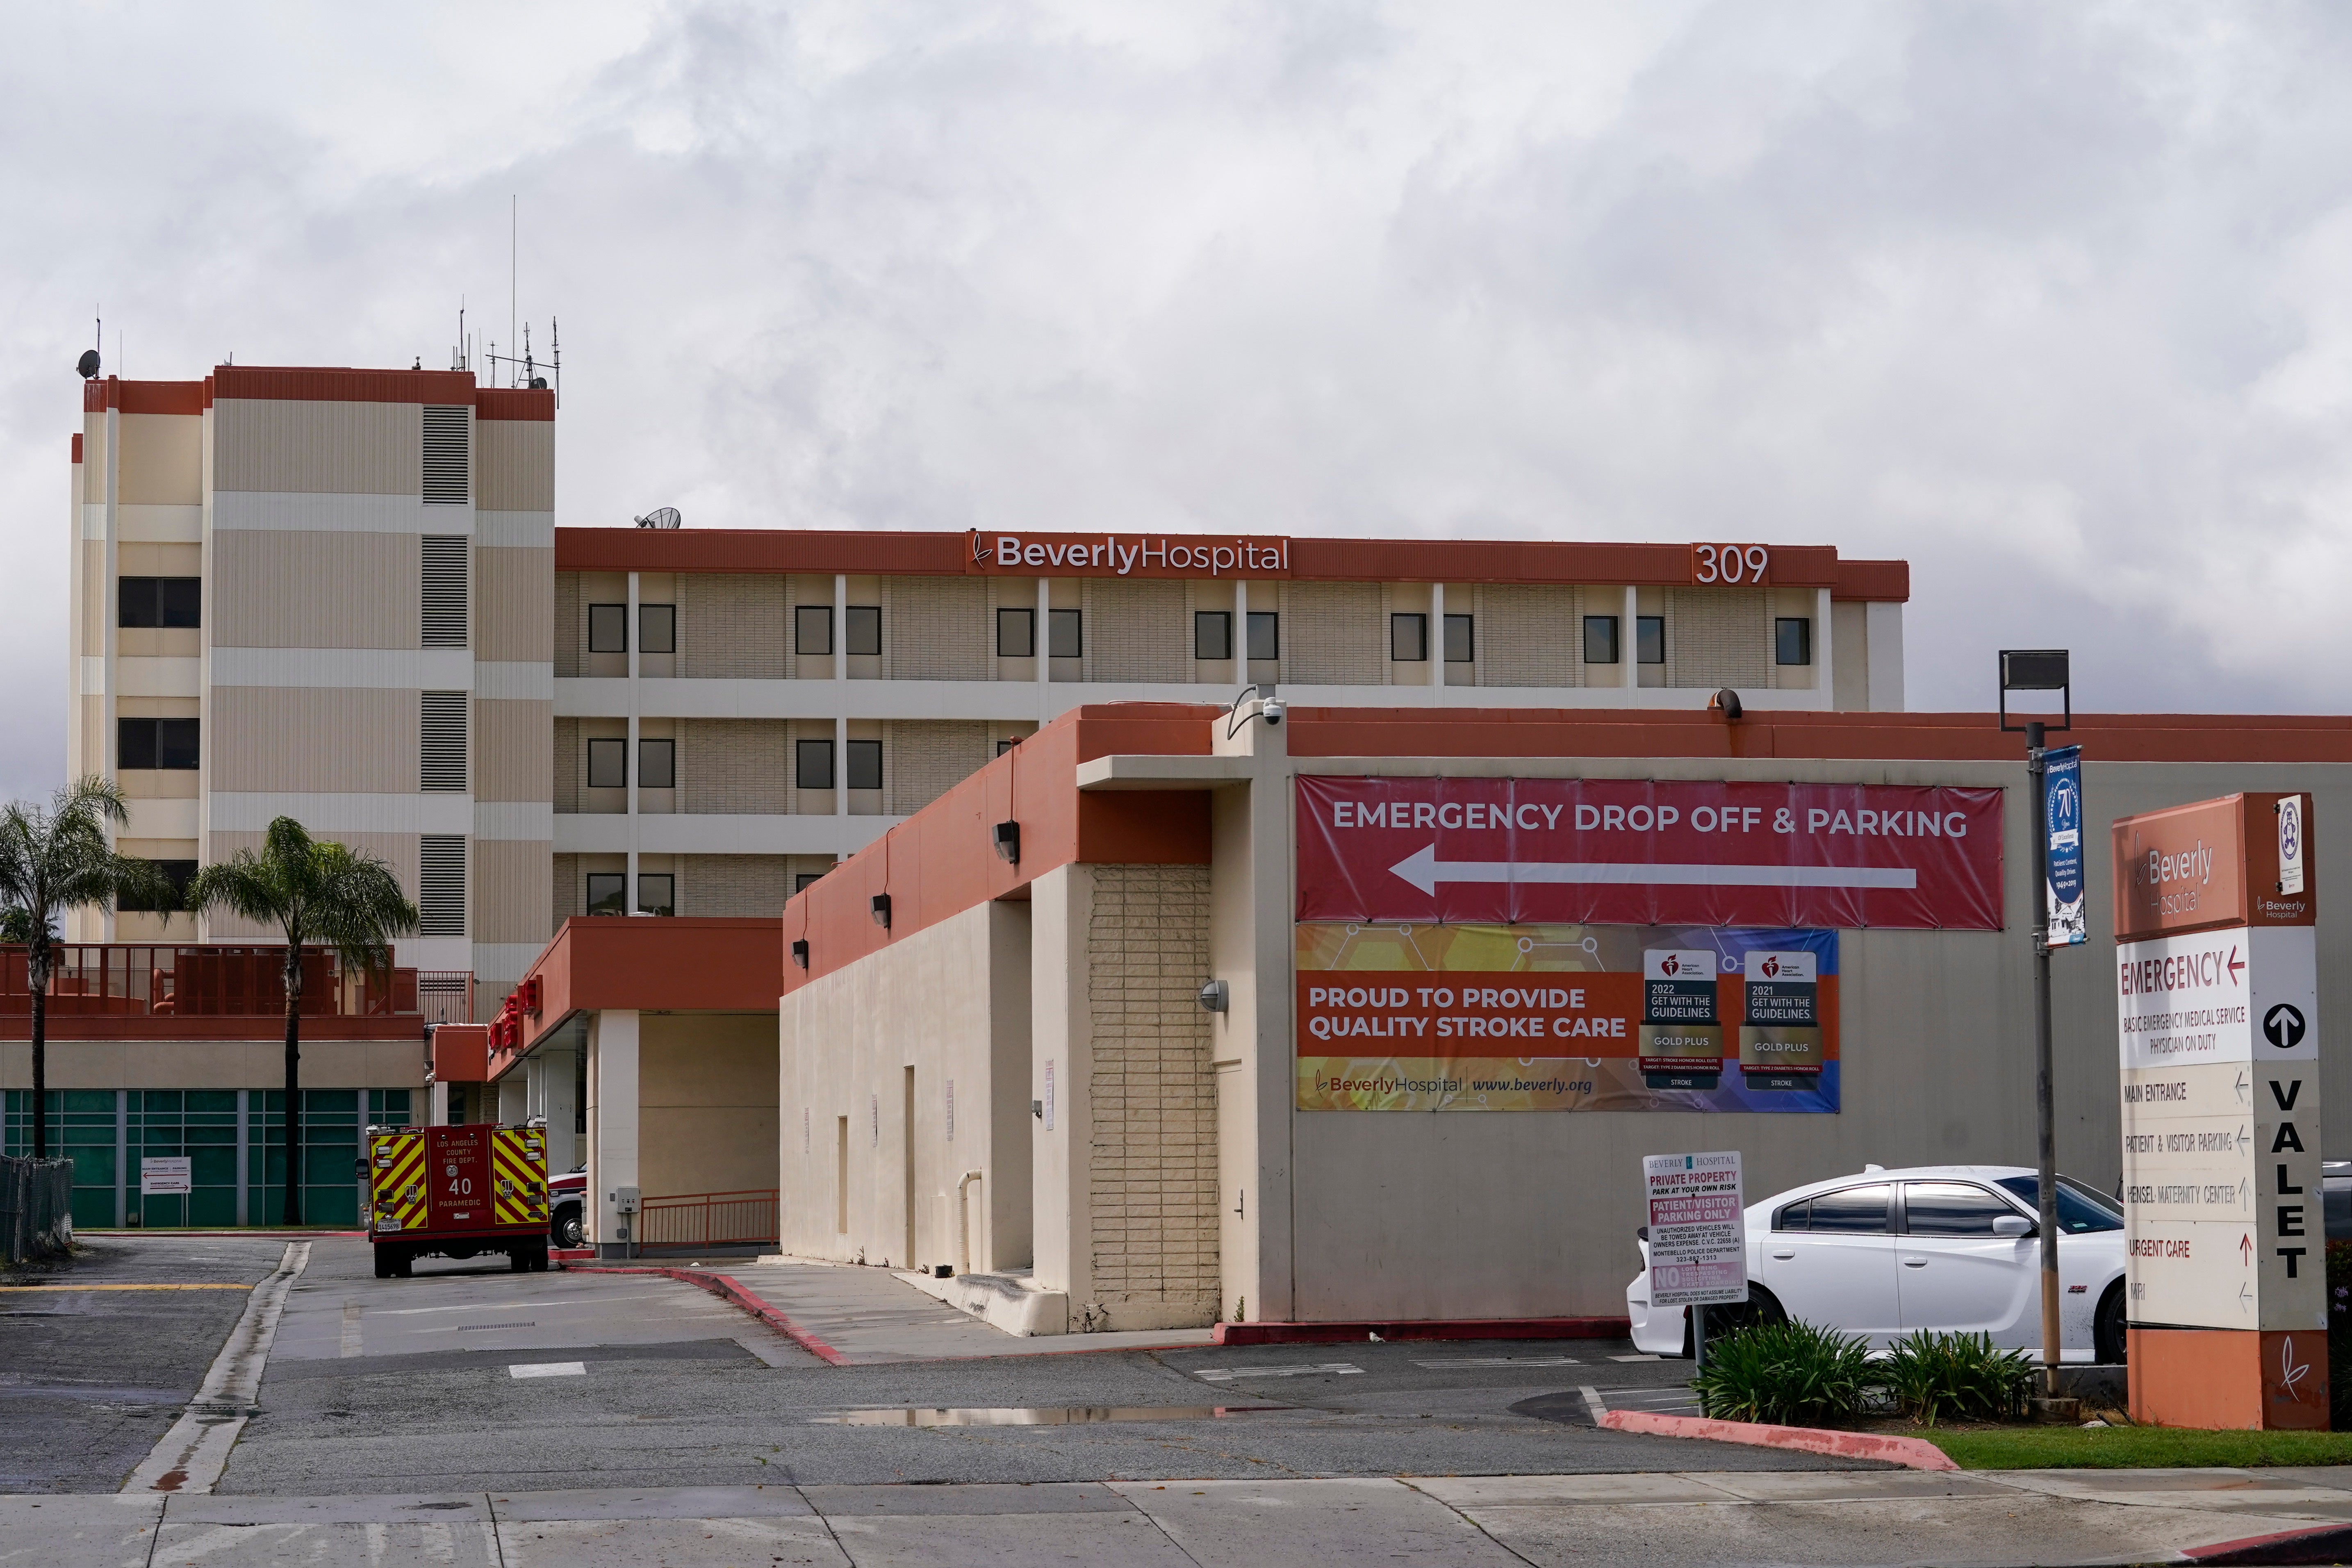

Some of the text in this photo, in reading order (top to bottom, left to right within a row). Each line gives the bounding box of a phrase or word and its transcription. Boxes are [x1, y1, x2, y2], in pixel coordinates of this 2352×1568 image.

[1696, 545, 1768, 583] 309
[2058, 788, 2070, 818] 70
[1334, 801, 1967, 838] EMERGENCY DROP OFF & PARKING
[2149, 839, 2212, 885] Beverly
[2150, 882, 2200, 919] Hospital
[2266, 901, 2305, 912] Beverly
[2266, 911, 2297, 919] Hospital
[2122, 951, 2223, 995] EMERGENCY
[1652, 984, 1674, 994] 2022
[1752, 986, 1773, 995] 2021
[1309, 988, 1585, 1008] PROUD TO PROVIDE
[1652, 997, 1710, 1006] GET WITH THE
[1752, 998, 1810, 1007] GET WITH THE
[2124, 1006, 2245, 1033] BASIC EMERGENCY MEDICAL SERVICE
[1309, 1017, 1626, 1040] QUALITY STROKE CARE
[1654, 1037, 1683, 1045] GOLD
[1755, 1043, 1808, 1051] GOLD PLUS
[2150, 1033, 2216, 1054] PHYSICIAN ON DUTY
[1472, 1078, 1592, 1095] www.beverly.org
[2125, 1082, 2186, 1103] MAIN ENTRANCE
[2126, 1132, 2232, 1153] PATIENT & VISITOR PARKING
[1649, 1156, 1735, 1168] BEVERLY HOSPITAL
[449, 1178, 471, 1195] 40
[1650, 1171, 1737, 1186] PRIVATE PROPERTY
[2268, 1080, 2306, 1278] VALET
[439, 1199, 480, 1207] PARAMEDIC
[2158, 1186, 2200, 1204] MATERNITY
[2204, 1186, 2236, 1204] CENTER
[1653, 1197, 1736, 1211] PATIENT/VISITOR
[1658, 1209, 1730, 1222] PARKING ONLY
[2129, 1239, 2190, 1258] URGENT CARE
[1655, 1267, 1679, 1287] NO
[2131, 1283, 2145, 1300] MRI
